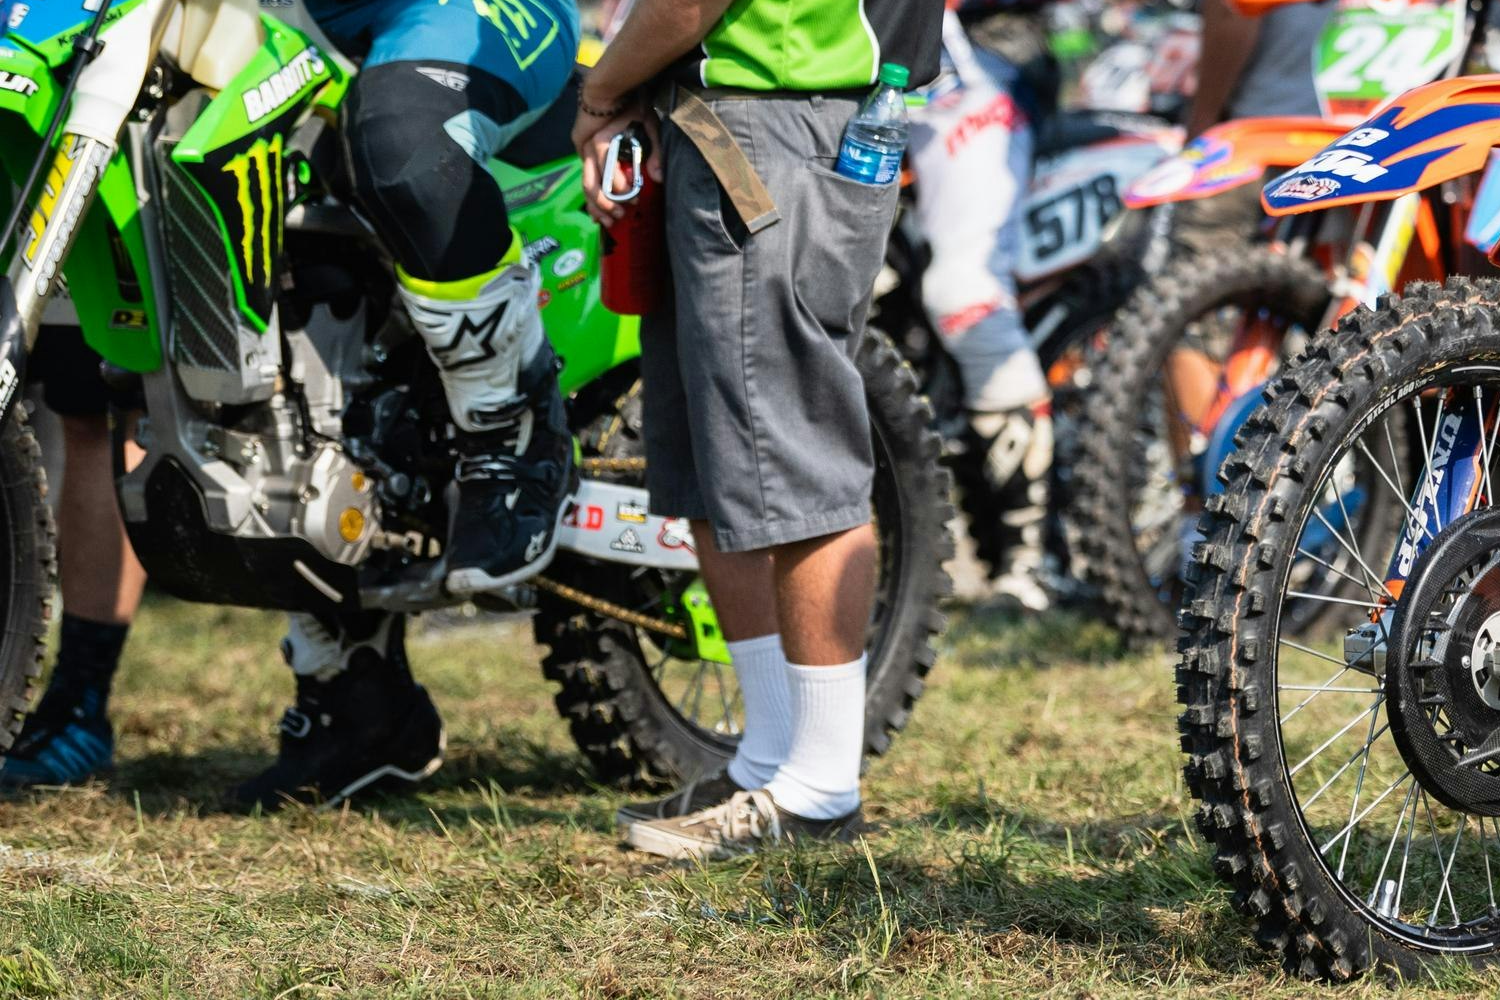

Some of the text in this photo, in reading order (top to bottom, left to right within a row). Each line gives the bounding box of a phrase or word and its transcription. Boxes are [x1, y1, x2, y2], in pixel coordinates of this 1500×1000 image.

[1316, 25, 1440, 93] 24
[1027, 175, 1123, 260] 578
[1366, 395, 1397, 425] EXCEL
